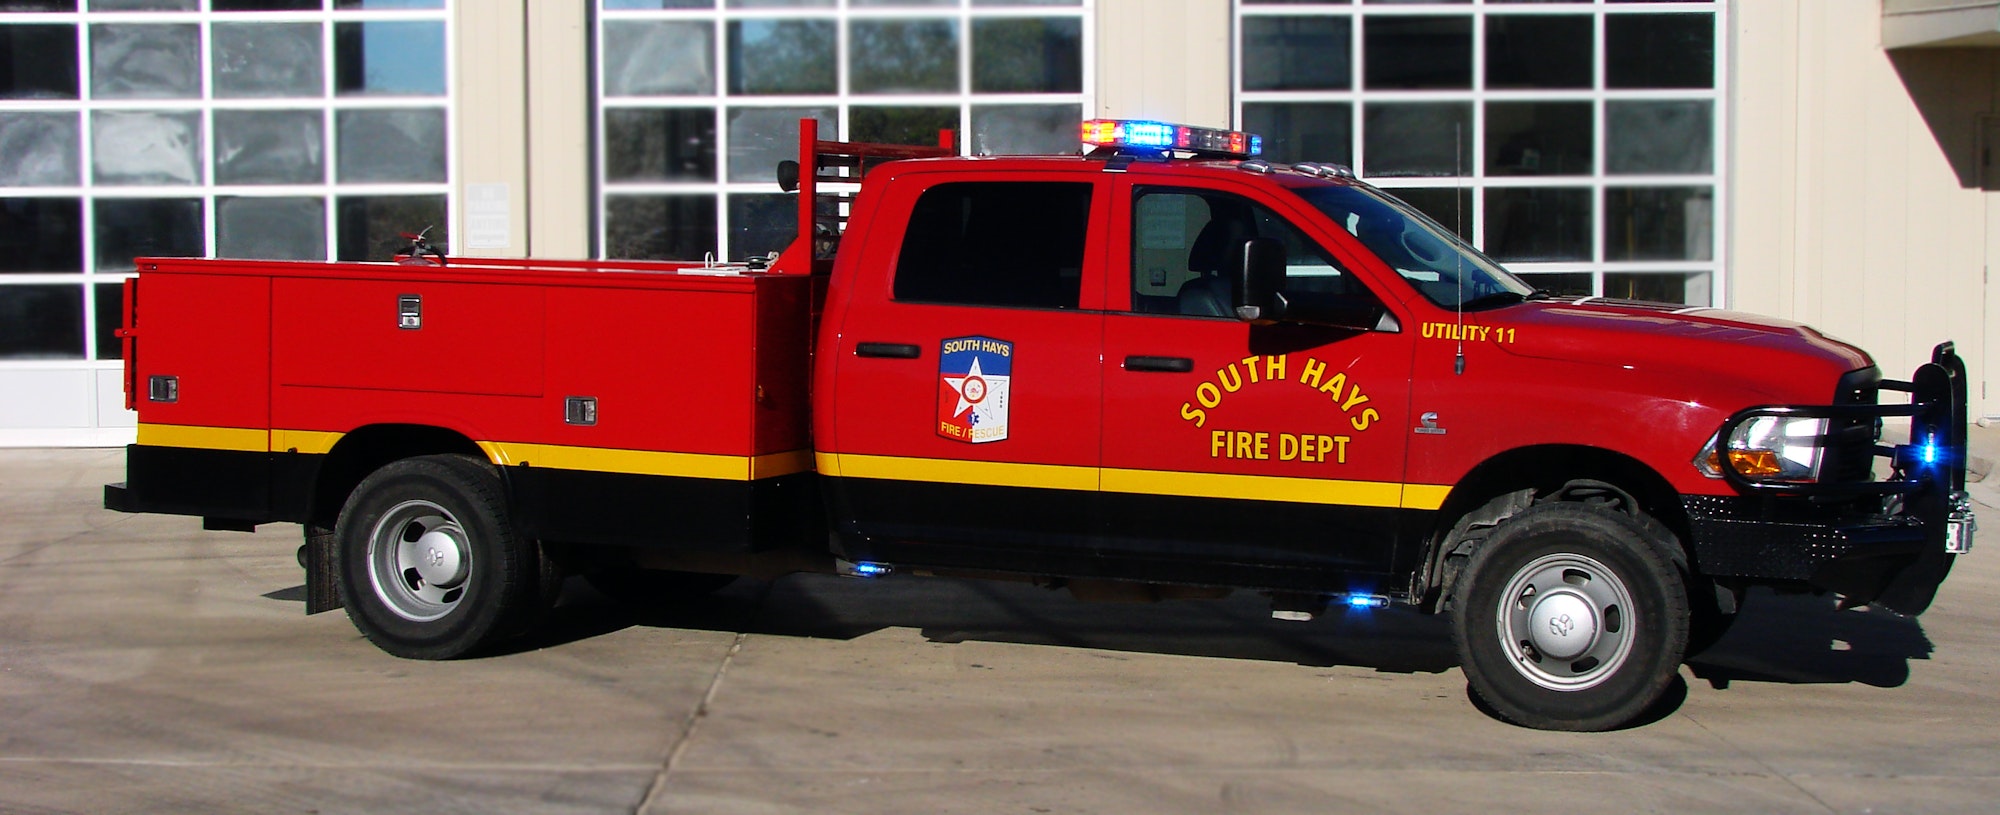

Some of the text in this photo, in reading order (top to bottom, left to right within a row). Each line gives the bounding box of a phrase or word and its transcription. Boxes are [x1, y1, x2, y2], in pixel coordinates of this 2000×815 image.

[1421, 322, 1515, 344] UTILITY 11
[943, 339, 1010, 357] SOUTH HAYS
[1180, 353, 1380, 431] SOUTH HAYS
[941, 422, 961, 437] FIRE
[968, 425, 1004, 439] RESCUE
[1210, 430, 1351, 464] FIRE DEPT
